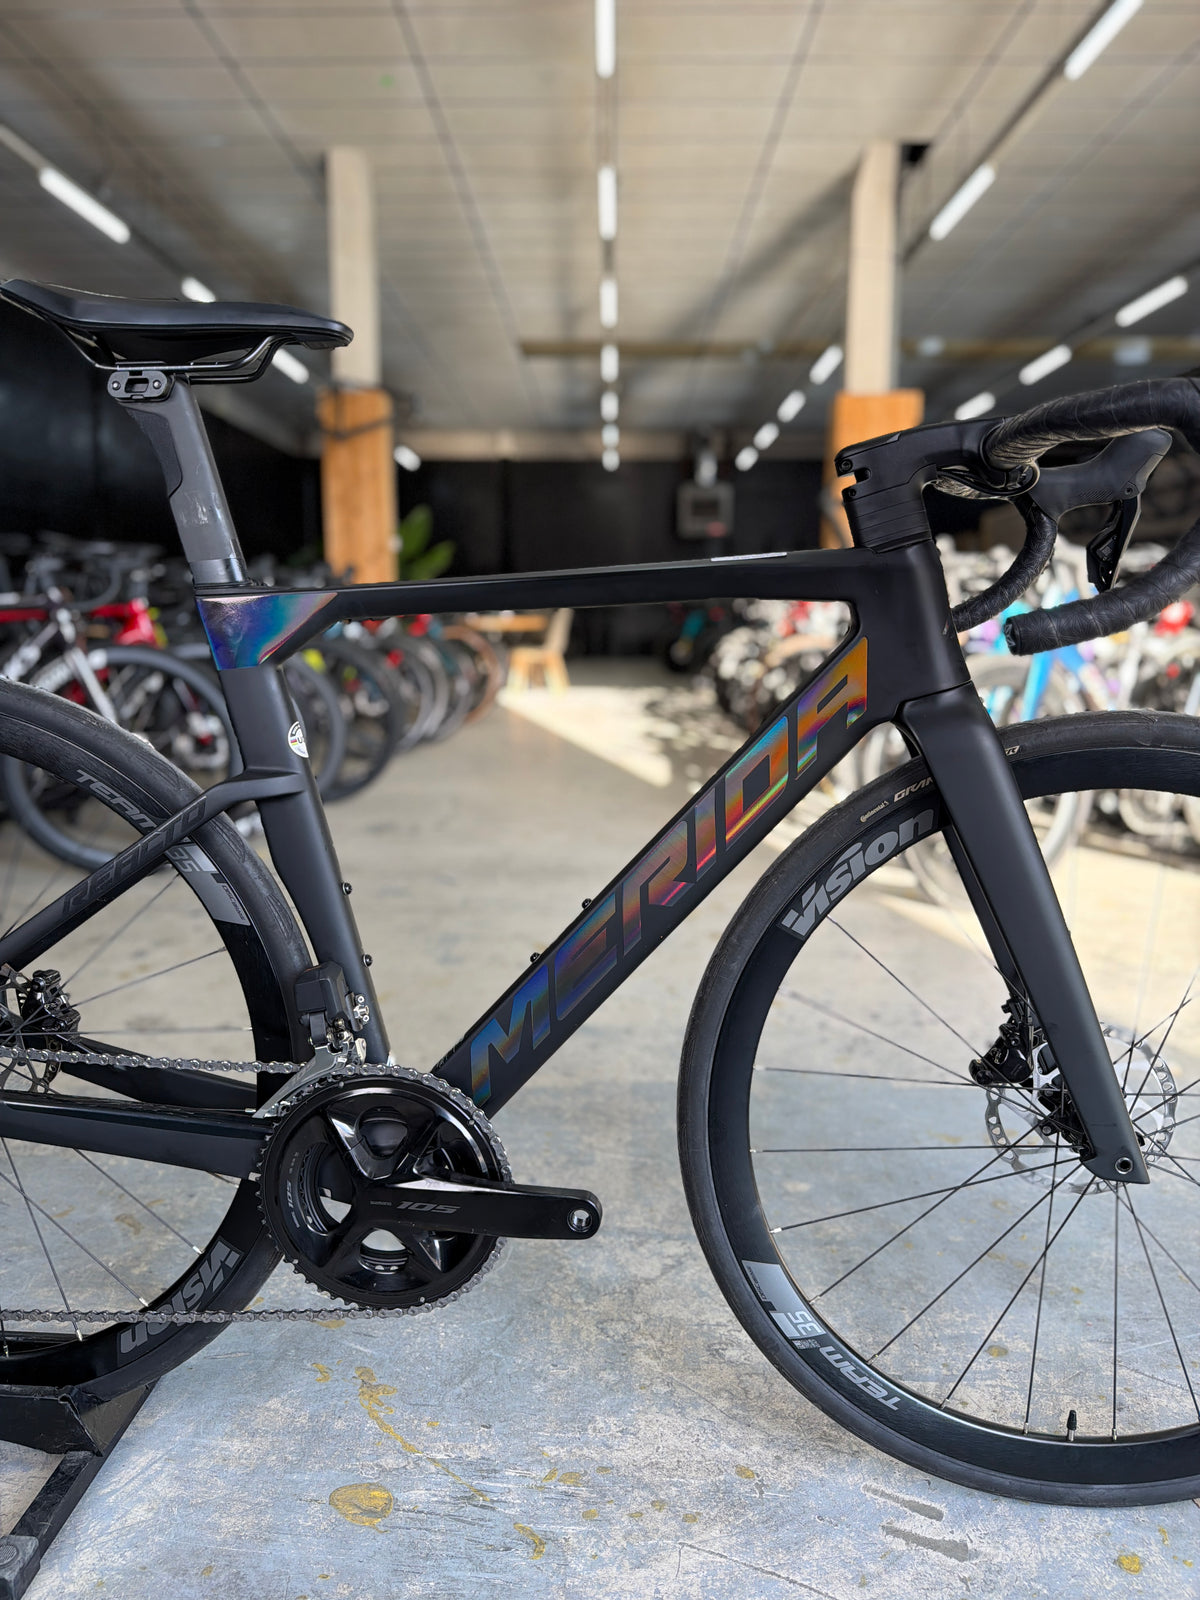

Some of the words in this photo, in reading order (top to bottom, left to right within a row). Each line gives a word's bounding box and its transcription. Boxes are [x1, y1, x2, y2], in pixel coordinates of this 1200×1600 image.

[894, 776, 933, 803] GRAN
[76, 769, 157, 829] TEAM
[165, 846, 201, 873] 35
[471, 637, 868, 1104] MERIDA
[396, 1201, 461, 1214] 105
[787, 1311, 823, 1337] 35
[819, 1345, 901, 1411] TEAM
